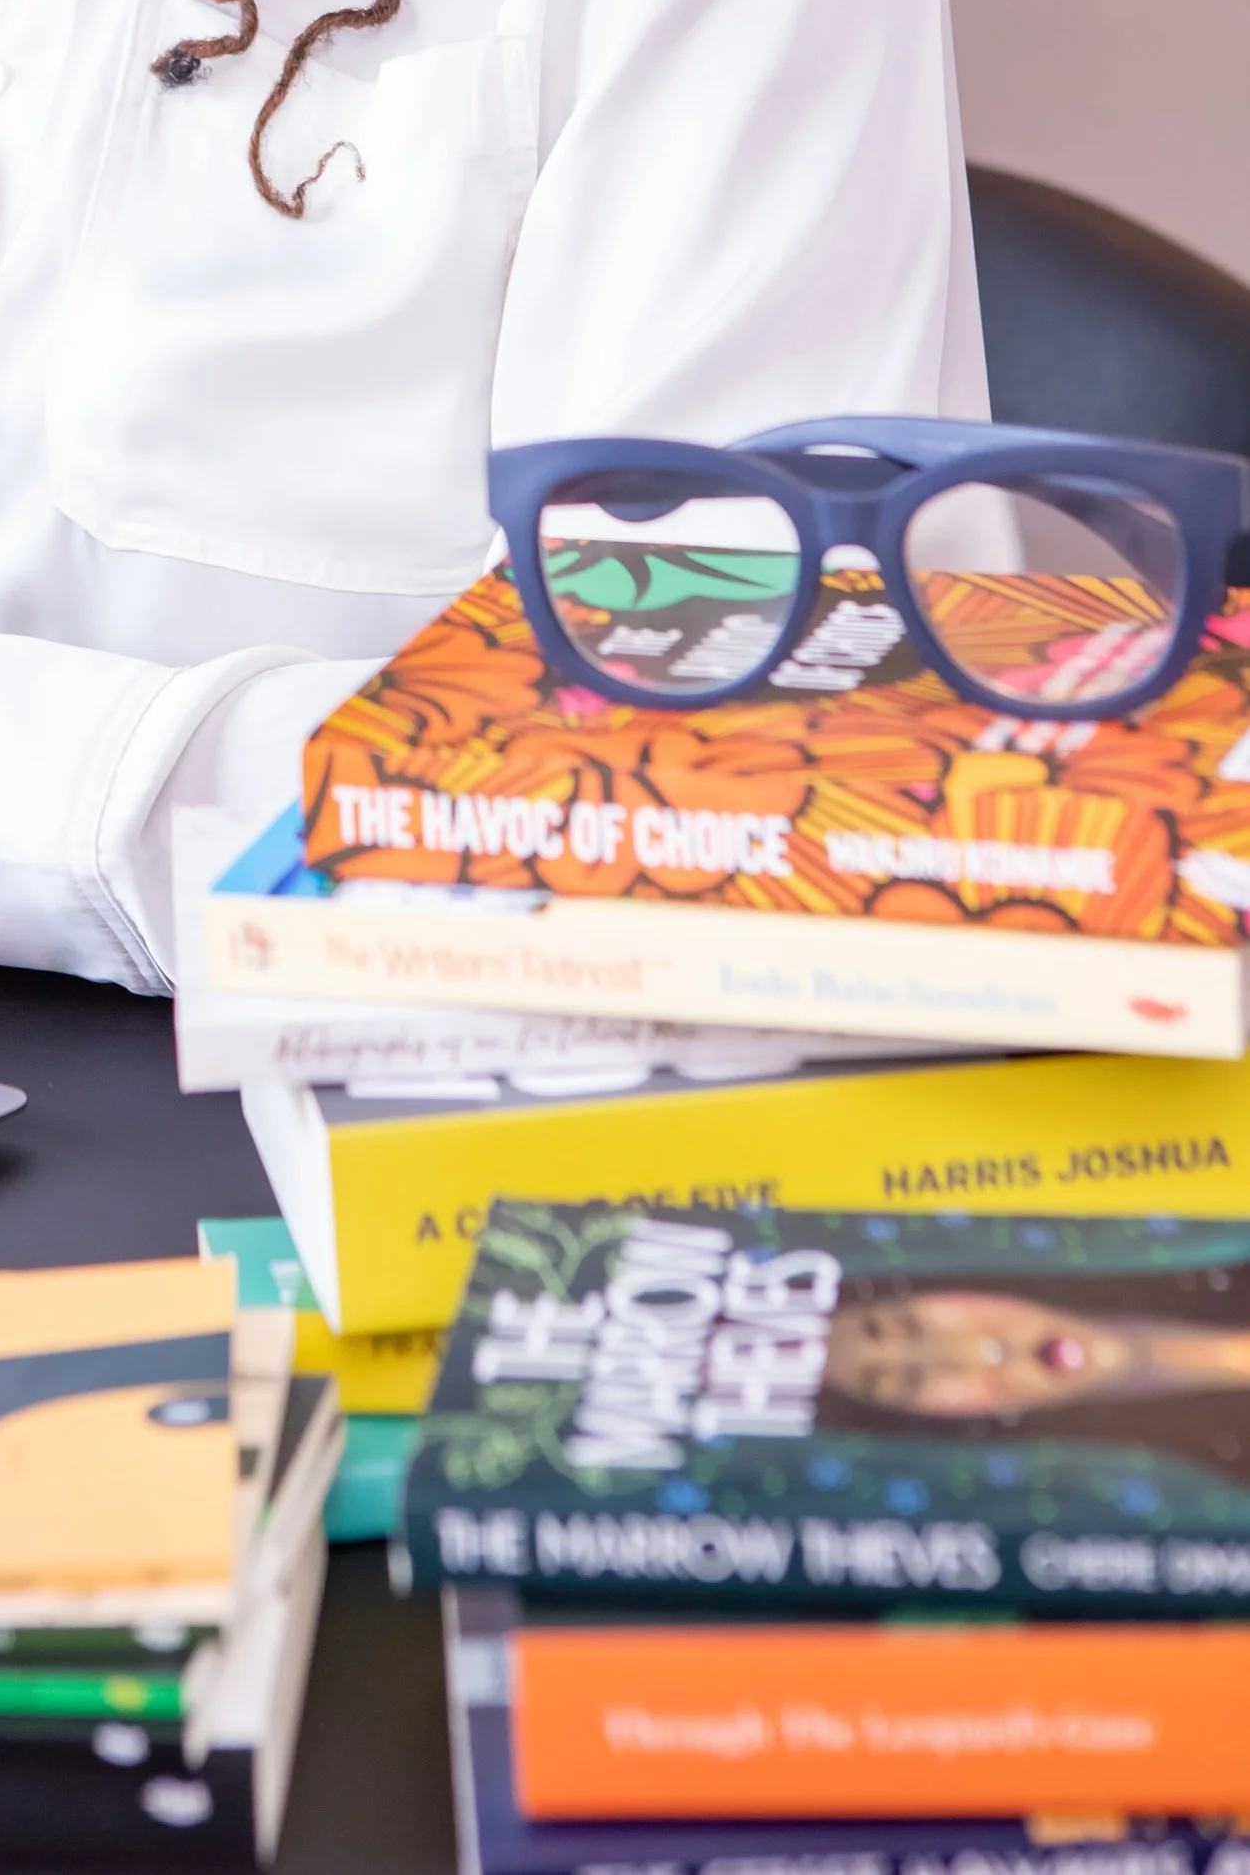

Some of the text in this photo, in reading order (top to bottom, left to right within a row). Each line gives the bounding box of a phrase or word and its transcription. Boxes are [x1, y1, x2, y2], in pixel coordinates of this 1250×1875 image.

[598, 624, 684, 656] THE
[331, 784, 795, 878] THE HAVOC OF CHOICE
[882, 1135, 1232, 1200] HARRIS JOSHUA
[416, 1211, 443, 1244] A
[472, 1289, 607, 1384] THE
[435, 1506, 1003, 1592] THE MARROW THIEVES
